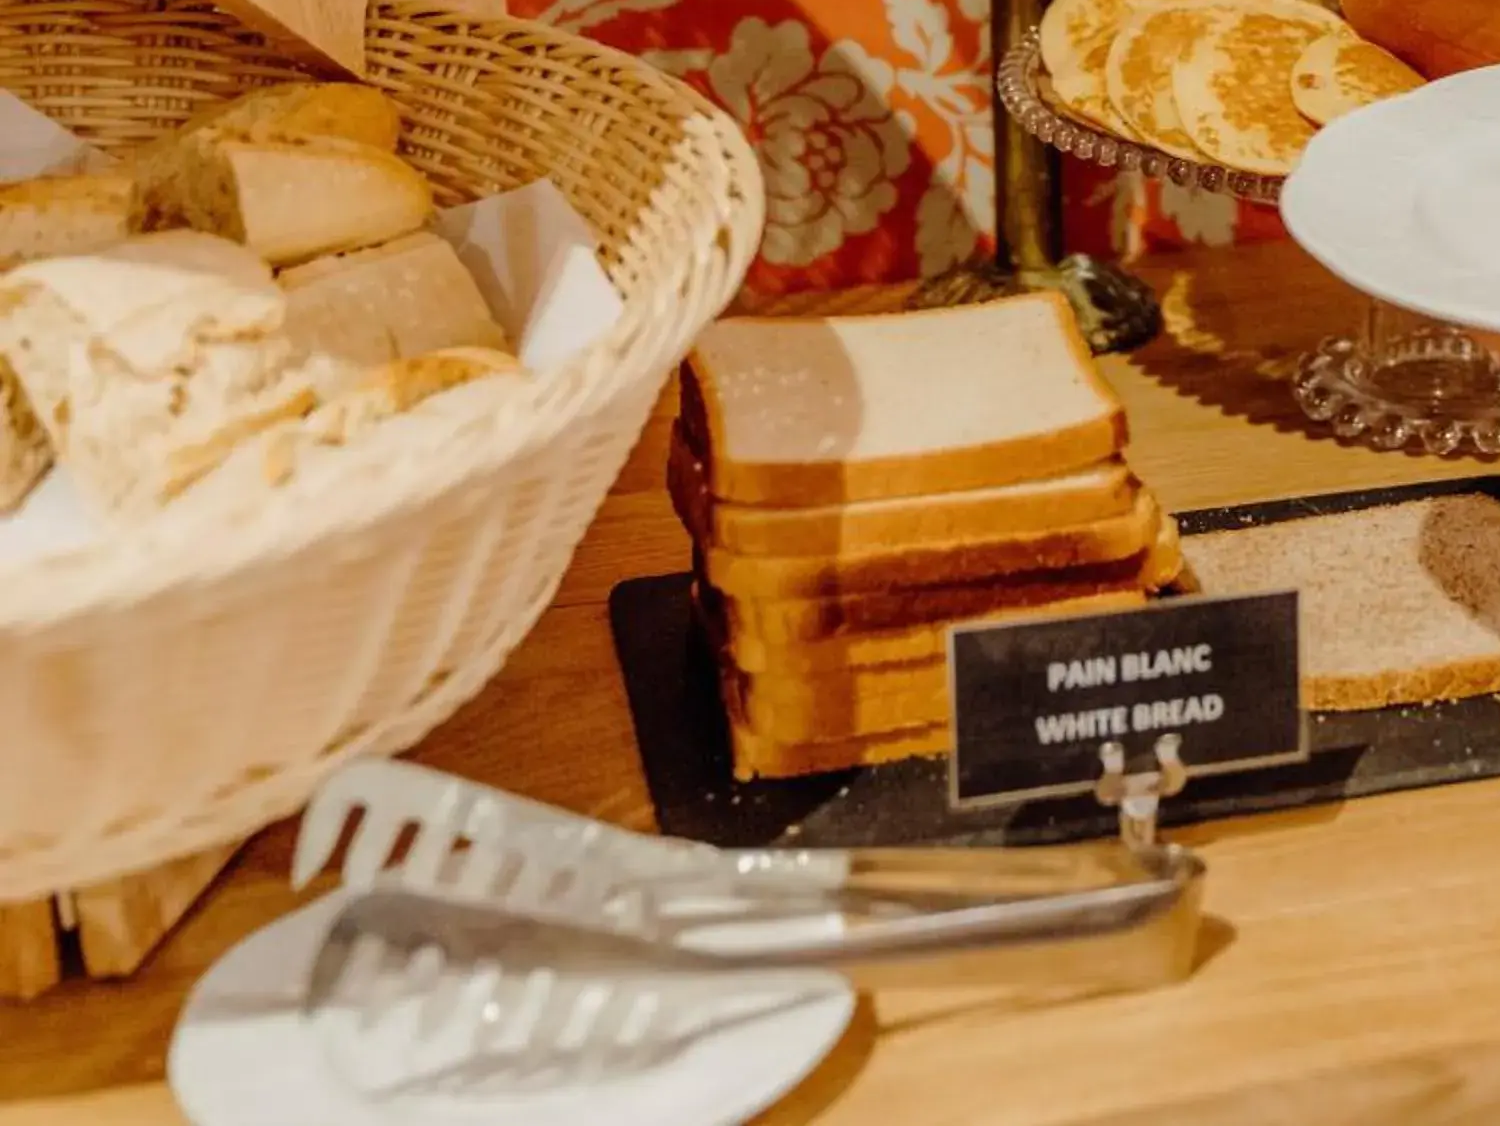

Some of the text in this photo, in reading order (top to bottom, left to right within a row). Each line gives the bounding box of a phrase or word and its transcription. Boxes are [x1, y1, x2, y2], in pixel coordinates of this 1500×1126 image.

[1046, 642, 1213, 693] PAIN BLANC
[1035, 693, 1224, 745] WHITE BREAD
